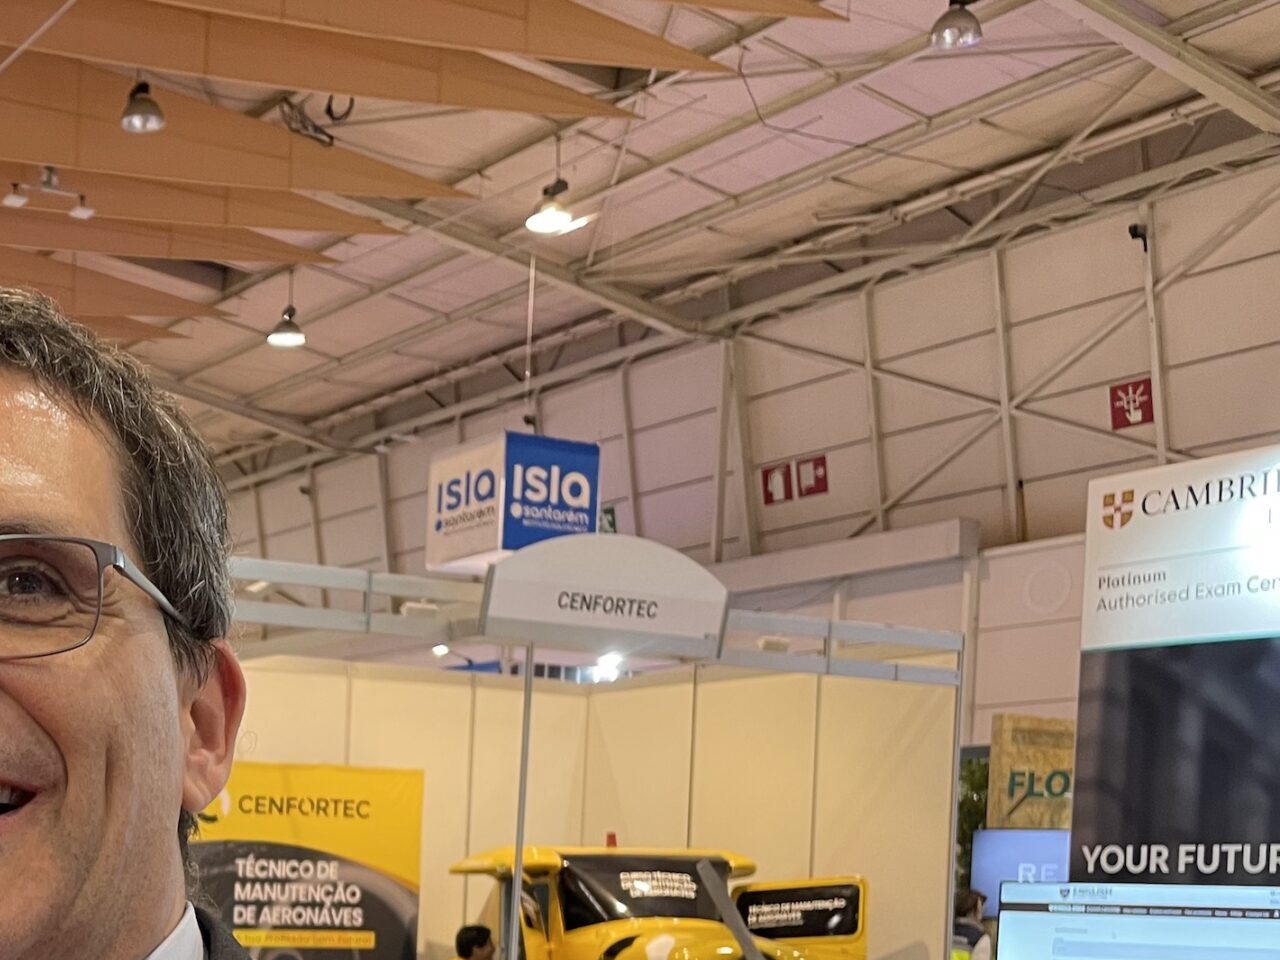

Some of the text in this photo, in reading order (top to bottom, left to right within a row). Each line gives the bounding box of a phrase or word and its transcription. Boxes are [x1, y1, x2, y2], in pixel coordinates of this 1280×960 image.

[1098, 571, 1166, 590] Platinum
[557, 590, 658, 619] CENFORTEC
[1096, 585, 1189, 613] Authorised
[1195, 580, 1241, 598] Exam
[238, 794, 371, 819] CENFORTEC
[234, 853, 339, 880] TÉCNICO DE
[1081, 844, 1170, 874] YOUR
[233, 880, 362, 906] MANUTENÇÃO
[232, 904, 364, 928] DE AERONAVES
